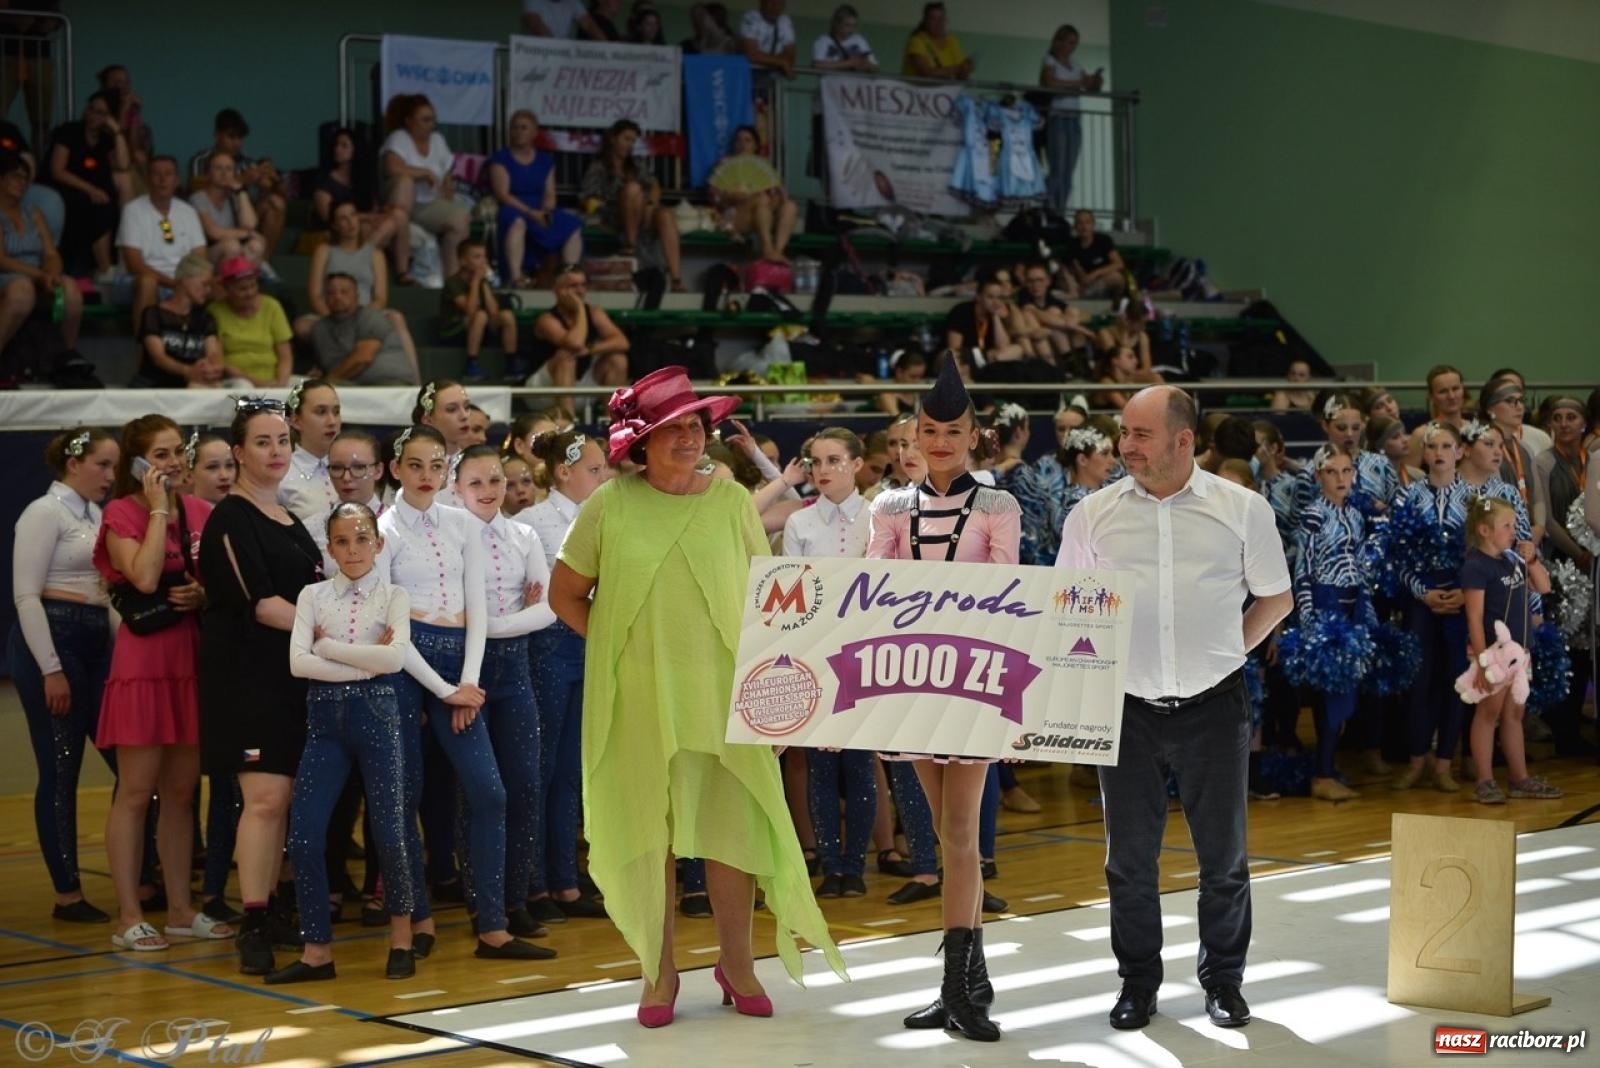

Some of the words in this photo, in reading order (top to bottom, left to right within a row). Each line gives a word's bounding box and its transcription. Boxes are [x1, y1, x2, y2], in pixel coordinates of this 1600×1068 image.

[553, 65, 638, 95] FINEZJA
[541, 94, 650, 121] NAJLEPSZA
[841, 85, 955, 119] MIESZKO
[837, 572, 1043, 629] Nagroda
[1079, 604, 1095, 614] MS
[763, 672, 813, 689] EUROPEAN
[854, 643, 959, 689] 1000
[963, 648, 1008, 696] ZŁ
[735, 693, 792, 712] MAJORETTES
[792, 687, 823, 702] SPORT
[1043, 720, 1078, 730] Fundator
[1079, 724, 1113, 734] nagrody:
[1011, 733, 1114, 751] Solidaris
[1415, 854, 1482, 975] 2
